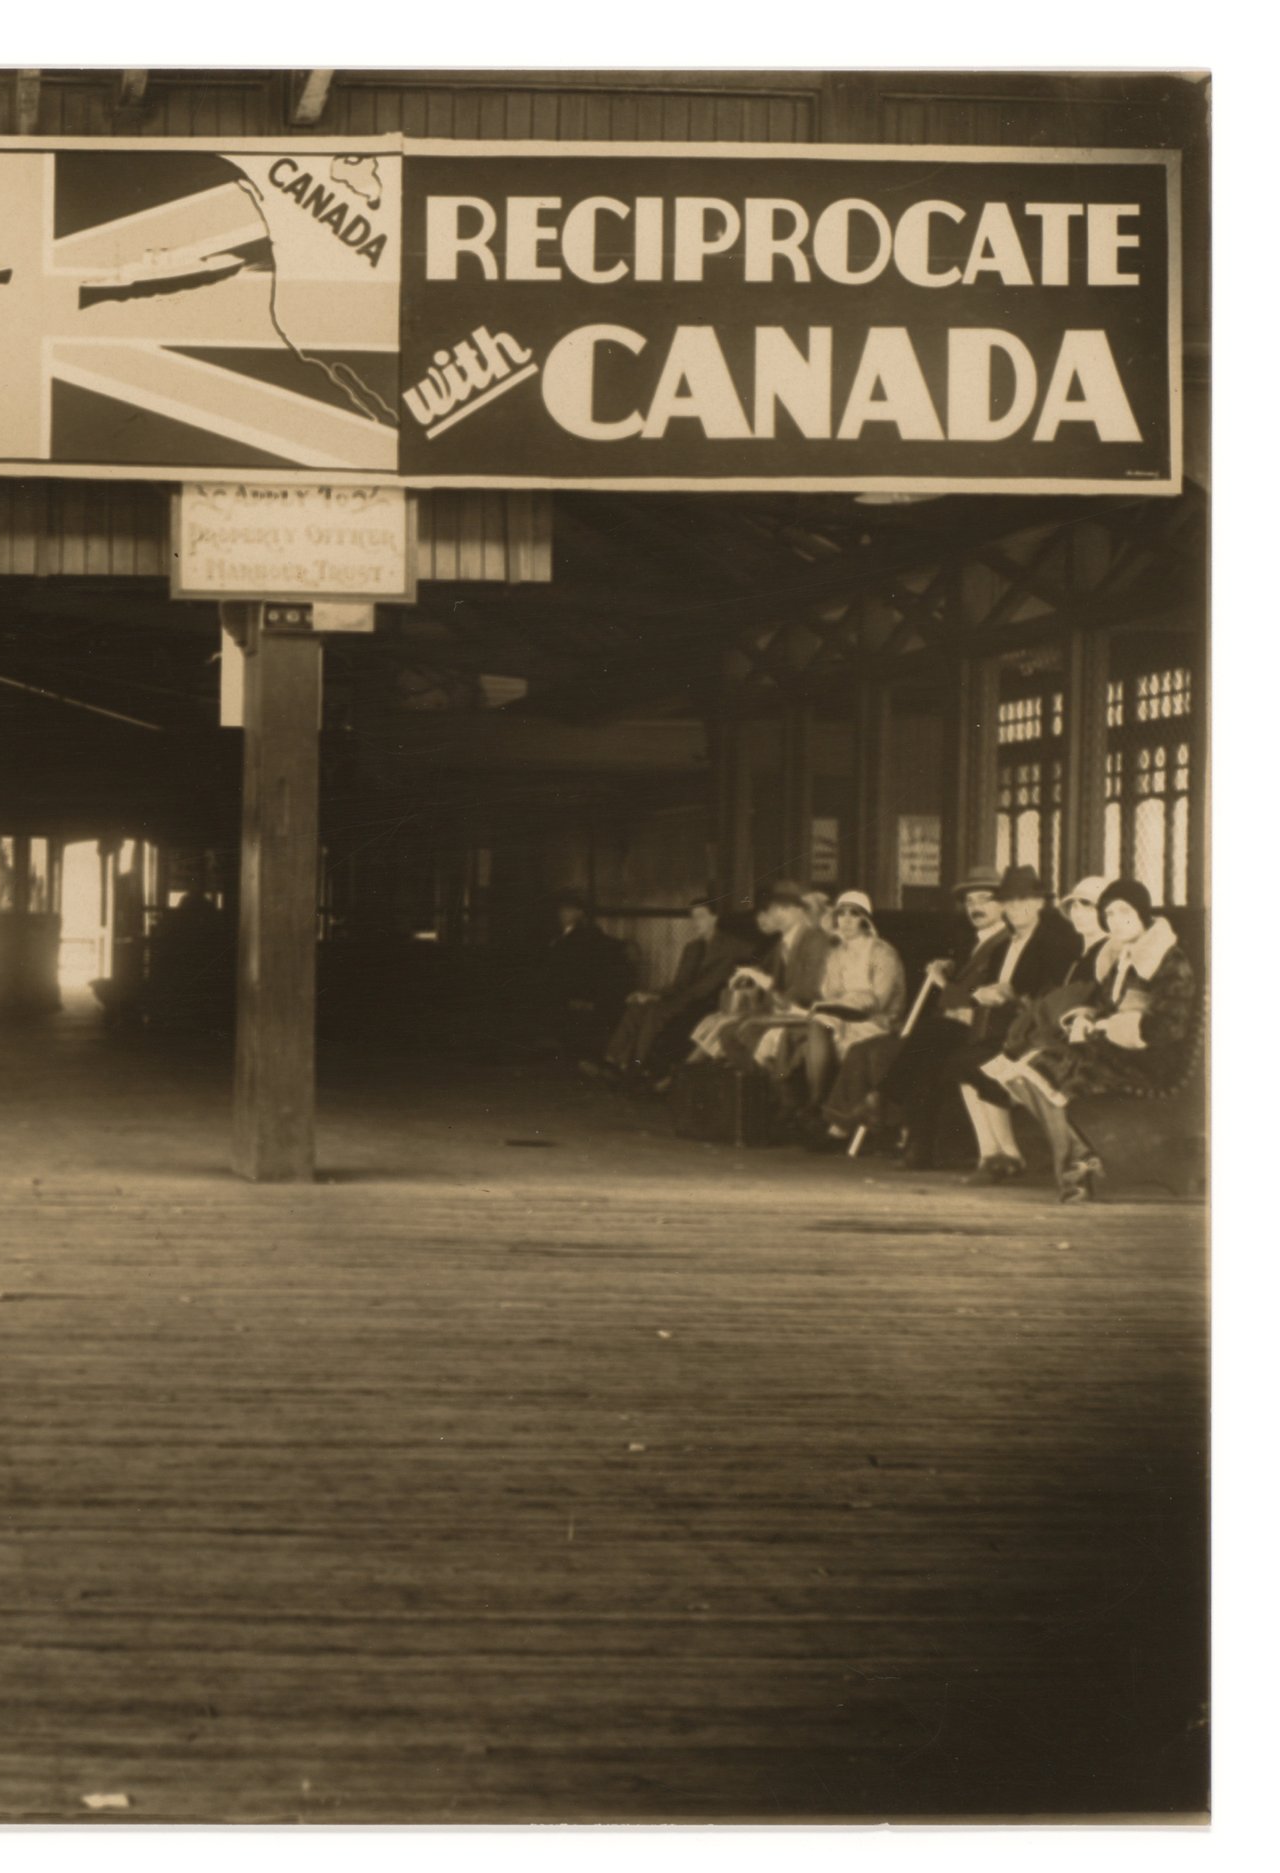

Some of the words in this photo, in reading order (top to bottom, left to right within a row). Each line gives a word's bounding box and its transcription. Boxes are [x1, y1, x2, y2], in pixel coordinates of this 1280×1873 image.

[267, 156, 390, 268] CANADA
[426, 196, 1140, 288] RECIPROCATE
[402, 325, 533, 426] with
[541, 323, 1144, 443] CANADA
